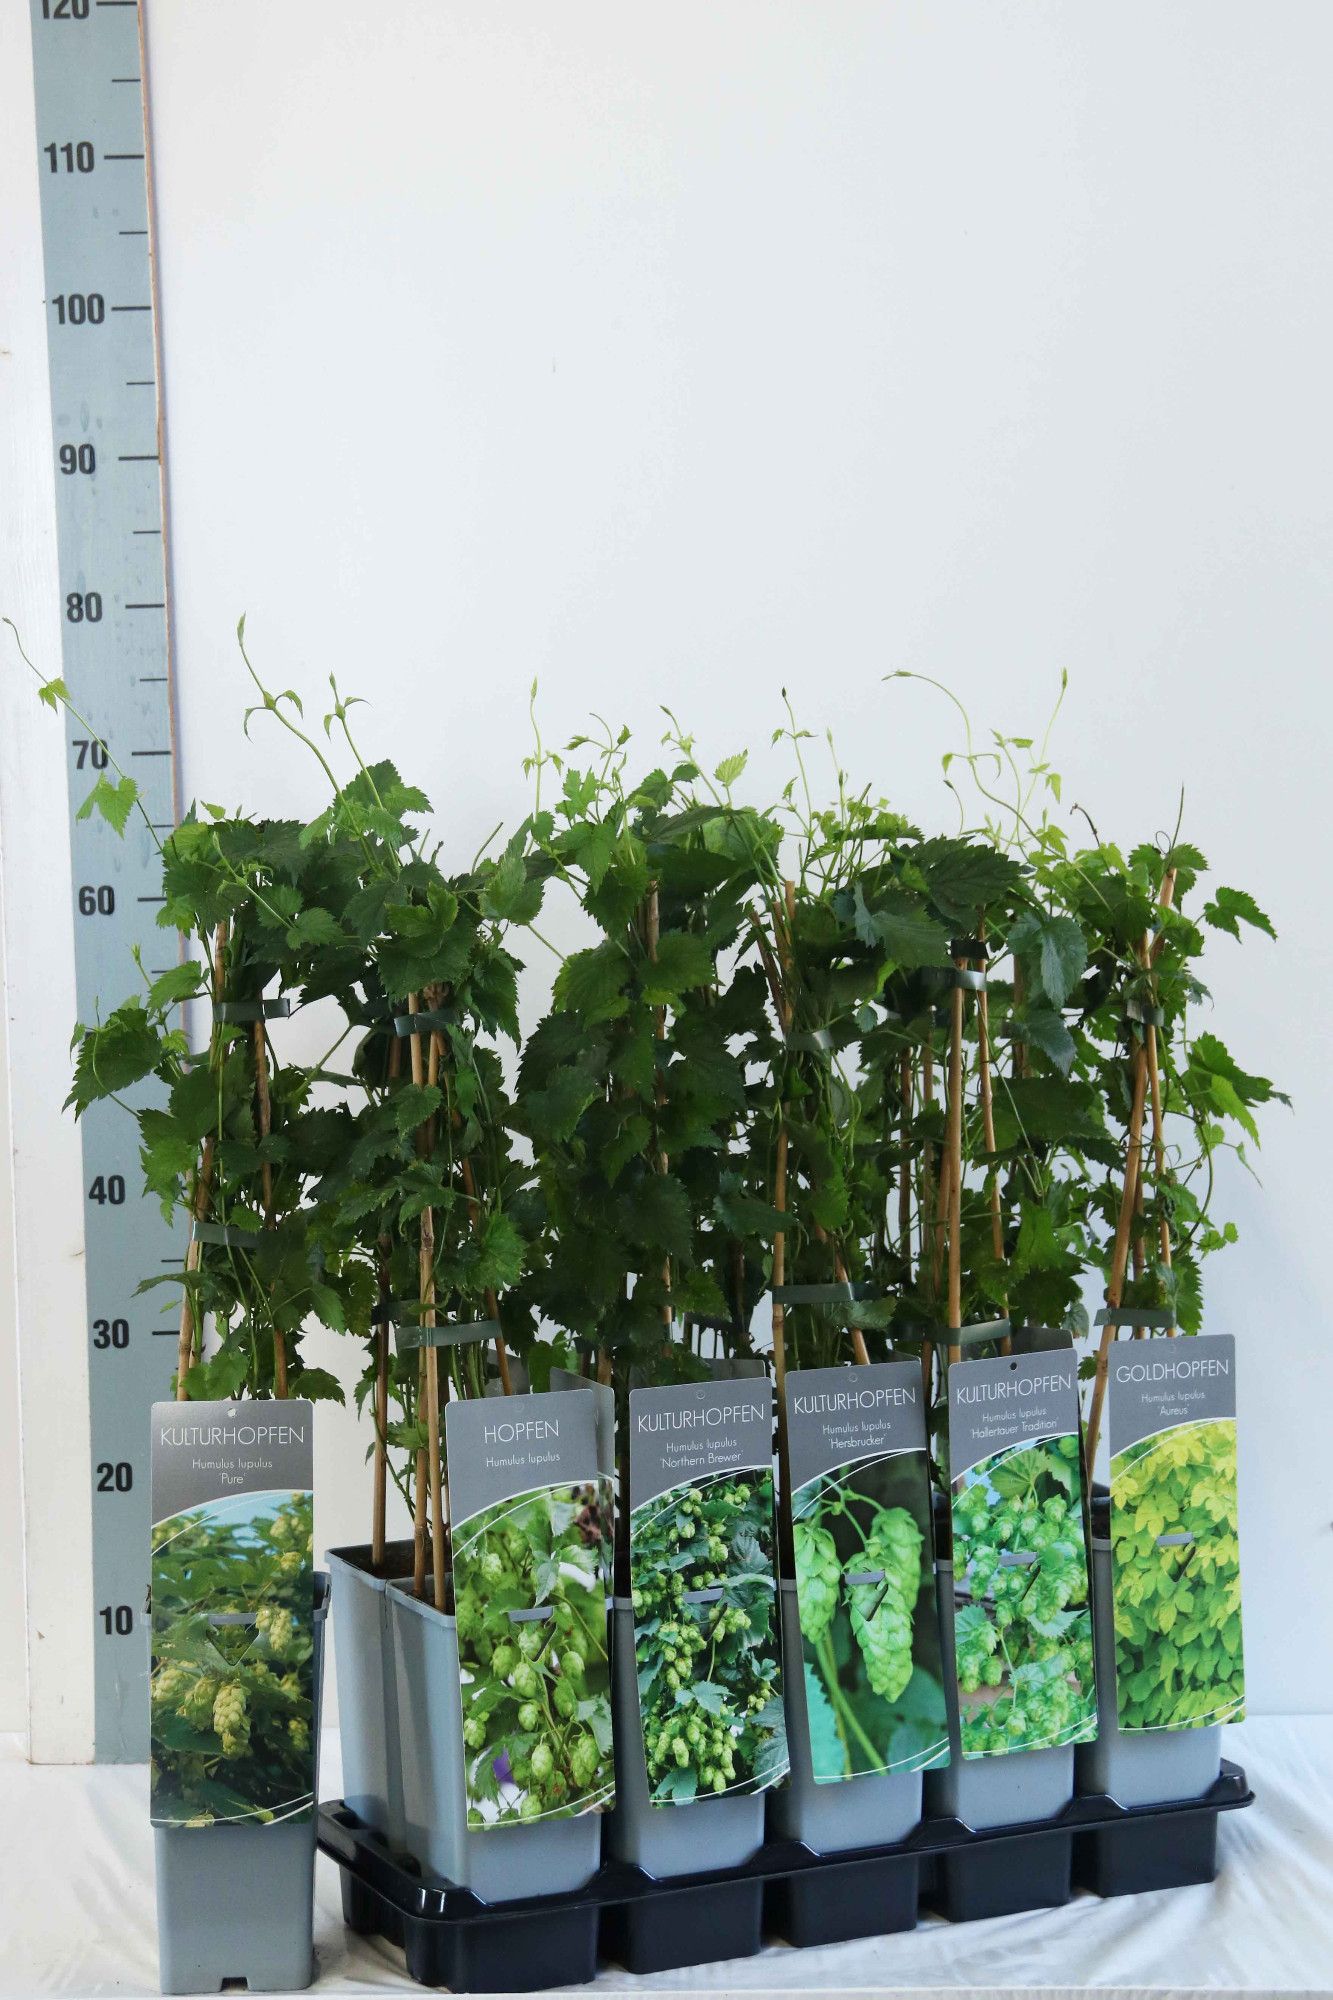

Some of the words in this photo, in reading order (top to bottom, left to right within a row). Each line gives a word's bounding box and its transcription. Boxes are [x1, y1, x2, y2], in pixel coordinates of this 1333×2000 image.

[42, 0, 90, 19] 120
[45, 141, 94, 173] 110
[52, 294, 104, 325] 100
[59, 444, 95, 474] 90
[66, 592, 102, 623] 80
[73, 740, 109, 770] 70
[79, 885, 116, 916] 60
[89, 1175, 126, 1206] 40
[93, 1319, 130, 1349] 30
[1116, 1359, 1229, 1383] GOLDHOPFEN
[794, 1387, 916, 1414] KULTURHOPFEN
[957, 1374, 1071, 1405] KULTURHOPFEN
[1141, 1392, 1175, 1404] Humulus
[1177, 1389, 1206, 1402] lupulus
[638, 1404, 764, 1433] KULTURHOPFEN
[822, 1423, 858, 1436] Humulus
[861, 1420, 891, 1433] lupulus
[982, 1411, 1017, 1423] Humulus
[1019, 1407, 1048, 1421] lupulus
[160, 1426, 304, 1446] KULTURHOPFEN
[484, 1420, 559, 1444] HOPFEN
[666, 1441, 703, 1453] Humulus
[706, 1437, 737, 1451] lupulus
[192, 1458, 234, 1470] Humulus
[238, 1458, 272, 1470] lupulus
[486, 1455, 525, 1468] Humulus
[529, 1452, 561, 1466] lupulus
[97, 1462, 133, 1493] 20
[100, 1606, 133, 1636] 10
